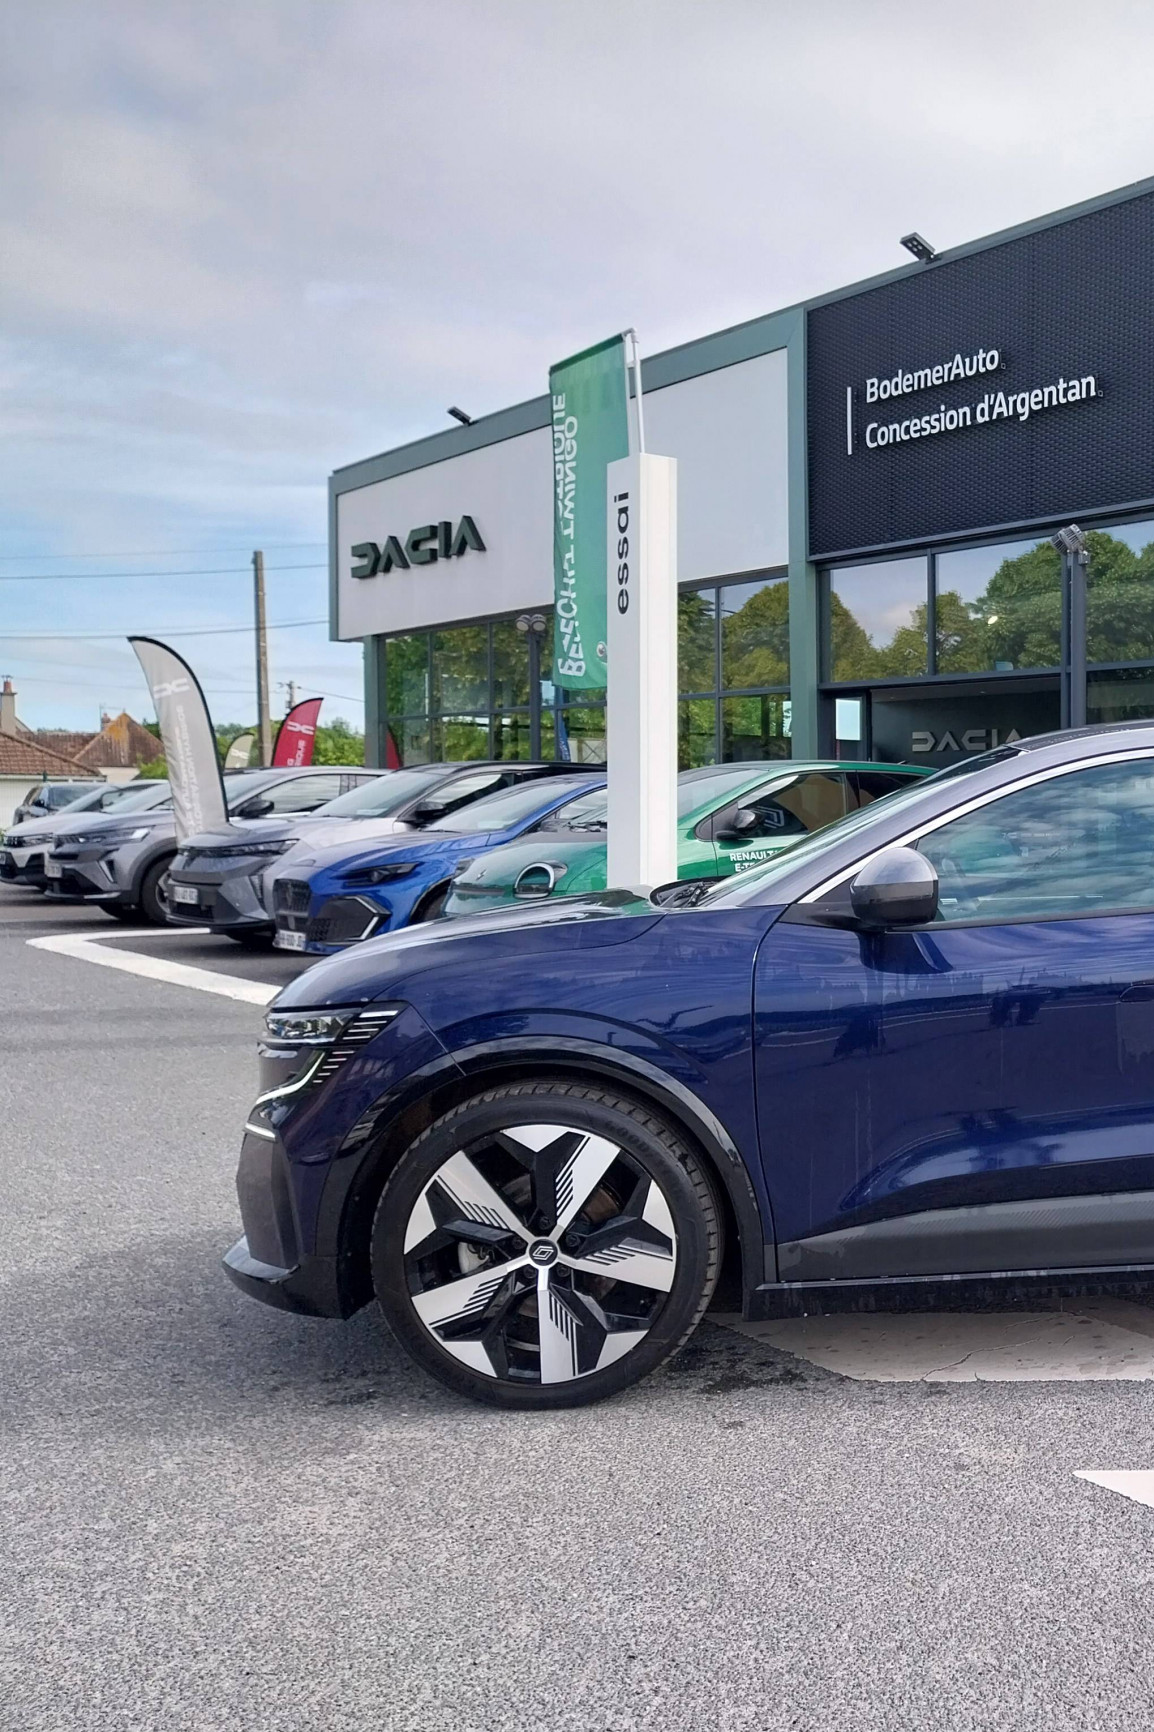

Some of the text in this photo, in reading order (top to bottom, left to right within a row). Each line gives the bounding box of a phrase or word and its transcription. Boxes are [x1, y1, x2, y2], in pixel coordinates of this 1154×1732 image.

[865, 348, 999, 403] BodemerAuto
[865, 375, 1096, 449] Concession d'Argentan
[351, 514, 486, 579] DACIA
[613, 490, 630, 615] essai
